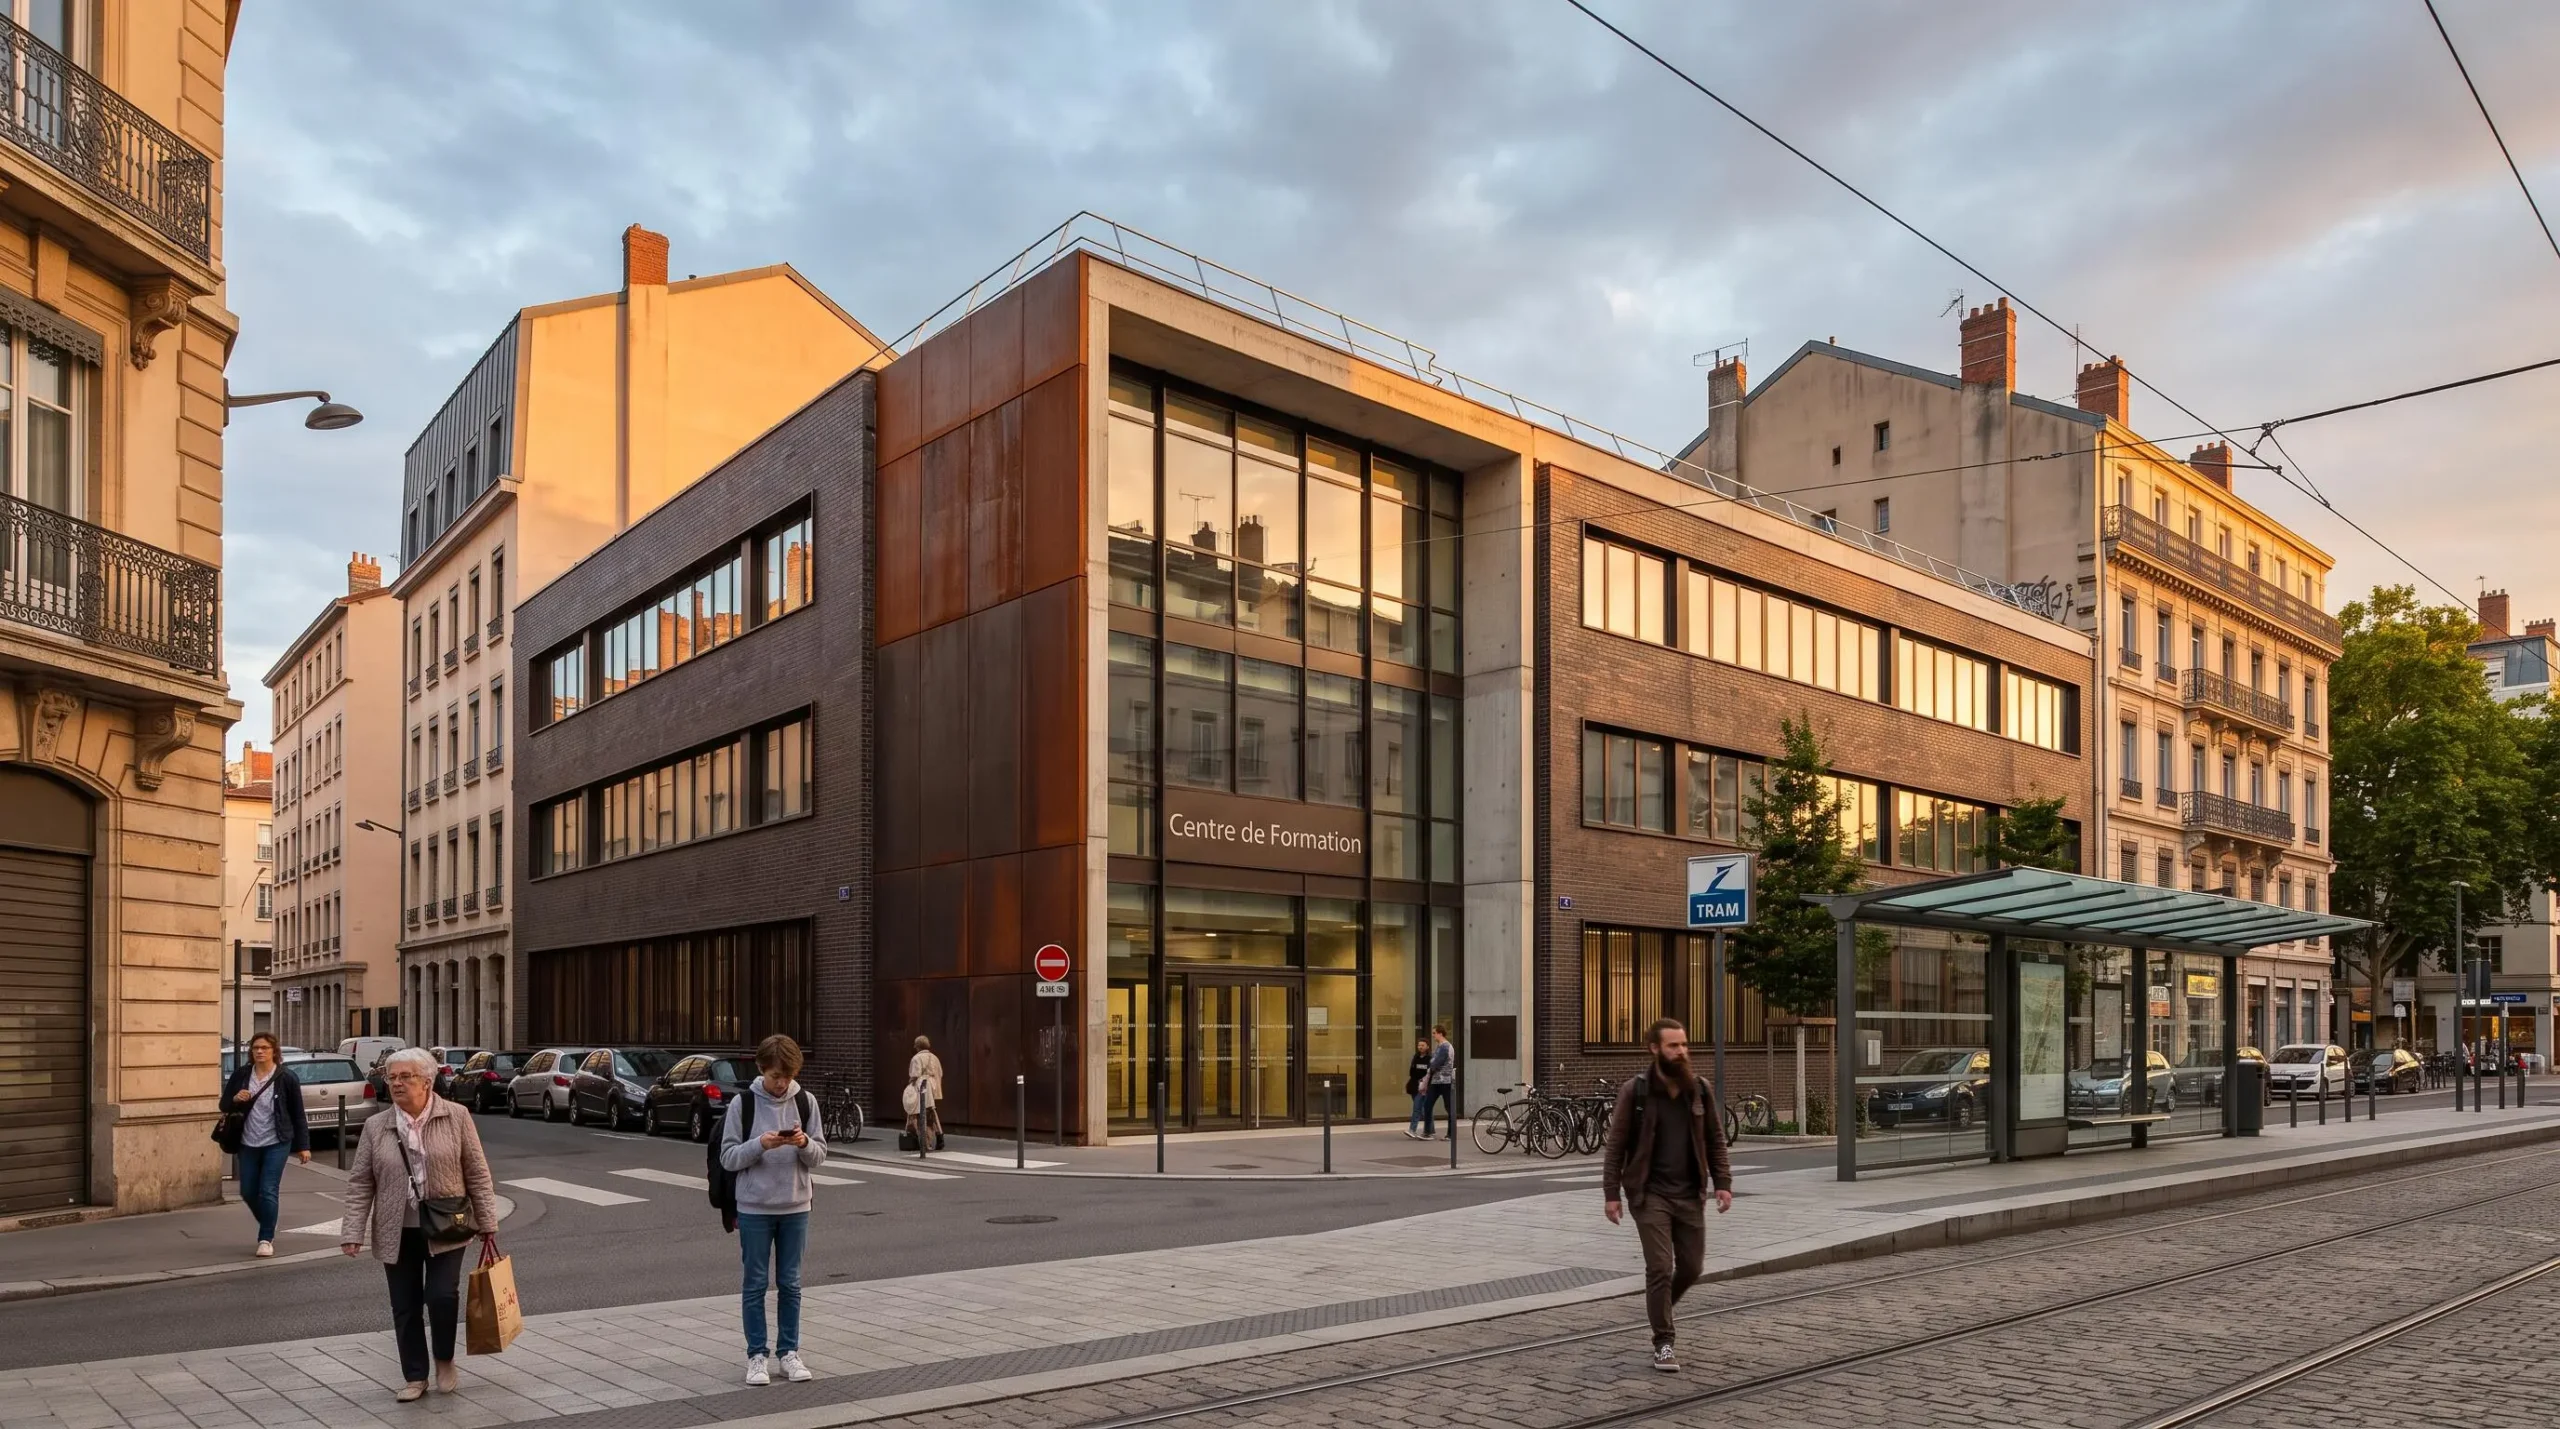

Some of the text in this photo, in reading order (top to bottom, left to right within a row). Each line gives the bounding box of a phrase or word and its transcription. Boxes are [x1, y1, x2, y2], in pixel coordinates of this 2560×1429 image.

[1169, 813, 1361, 854] Centre de Formation
[1696, 902, 1739, 918] TRAM
